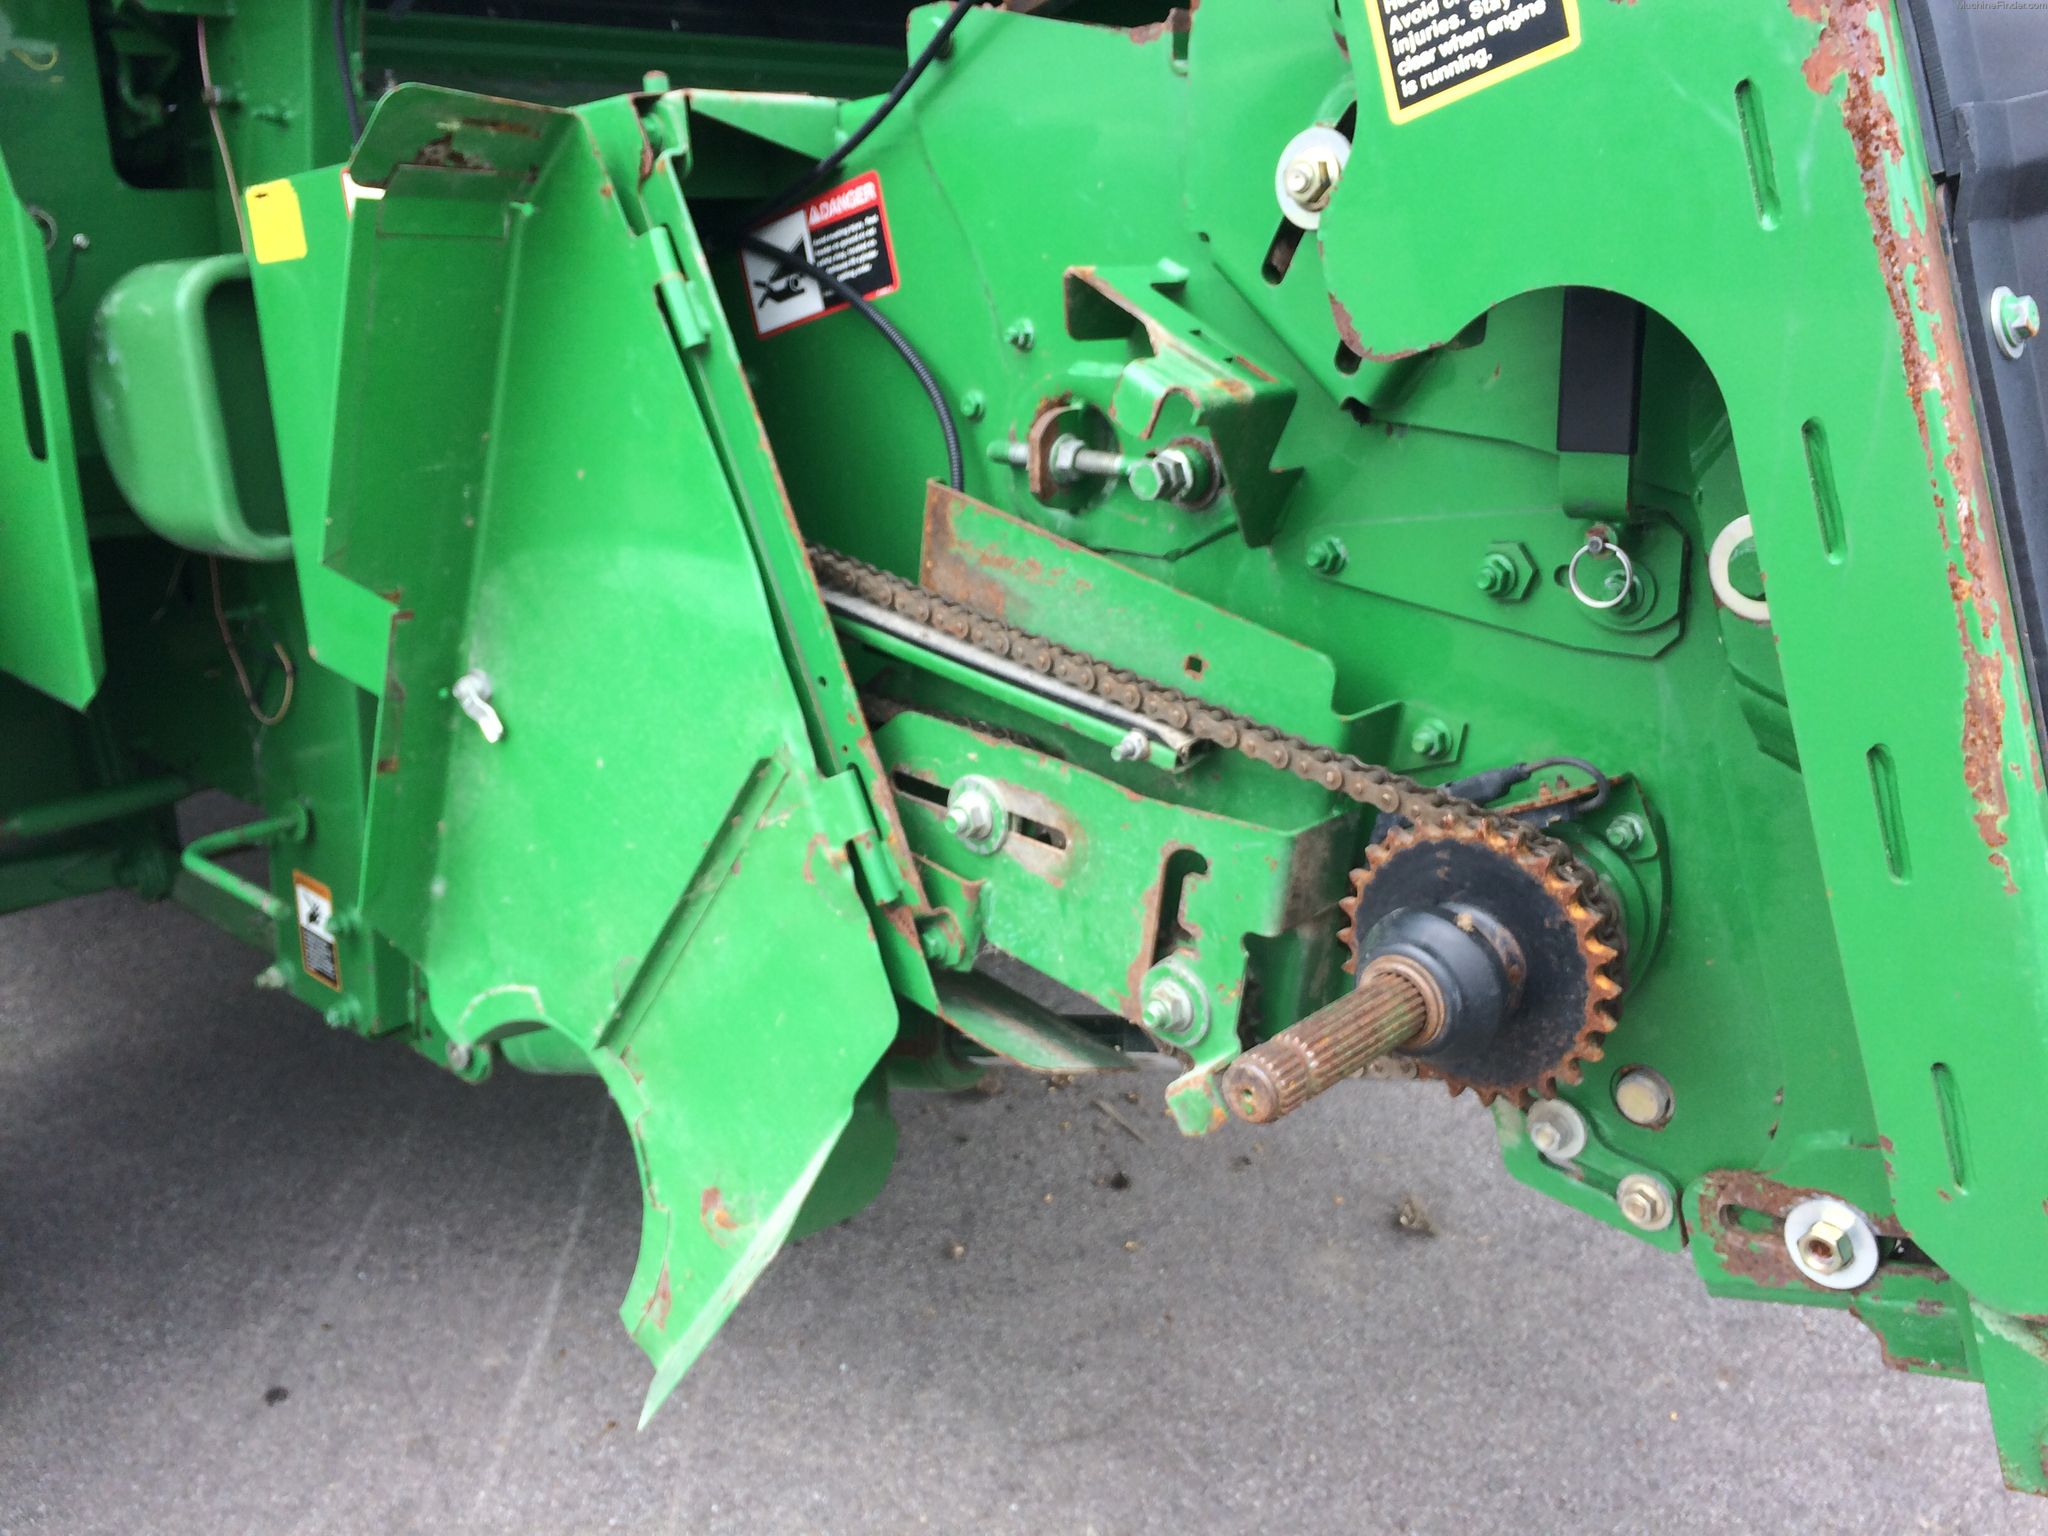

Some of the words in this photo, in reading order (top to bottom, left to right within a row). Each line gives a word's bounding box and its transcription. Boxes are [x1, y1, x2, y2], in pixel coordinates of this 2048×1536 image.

[1389, 0, 1439, 36] Avoid
[1392, 13, 1466, 56] injuries.
[1397, 46, 1437, 76] clear
[1438, 25, 1485, 58] when
[1486, 0, 1547, 36] engine
[1400, 79, 1418, 98] is
[1419, 47, 1493, 90] running.
[818, 181, 877, 221] DANGER
